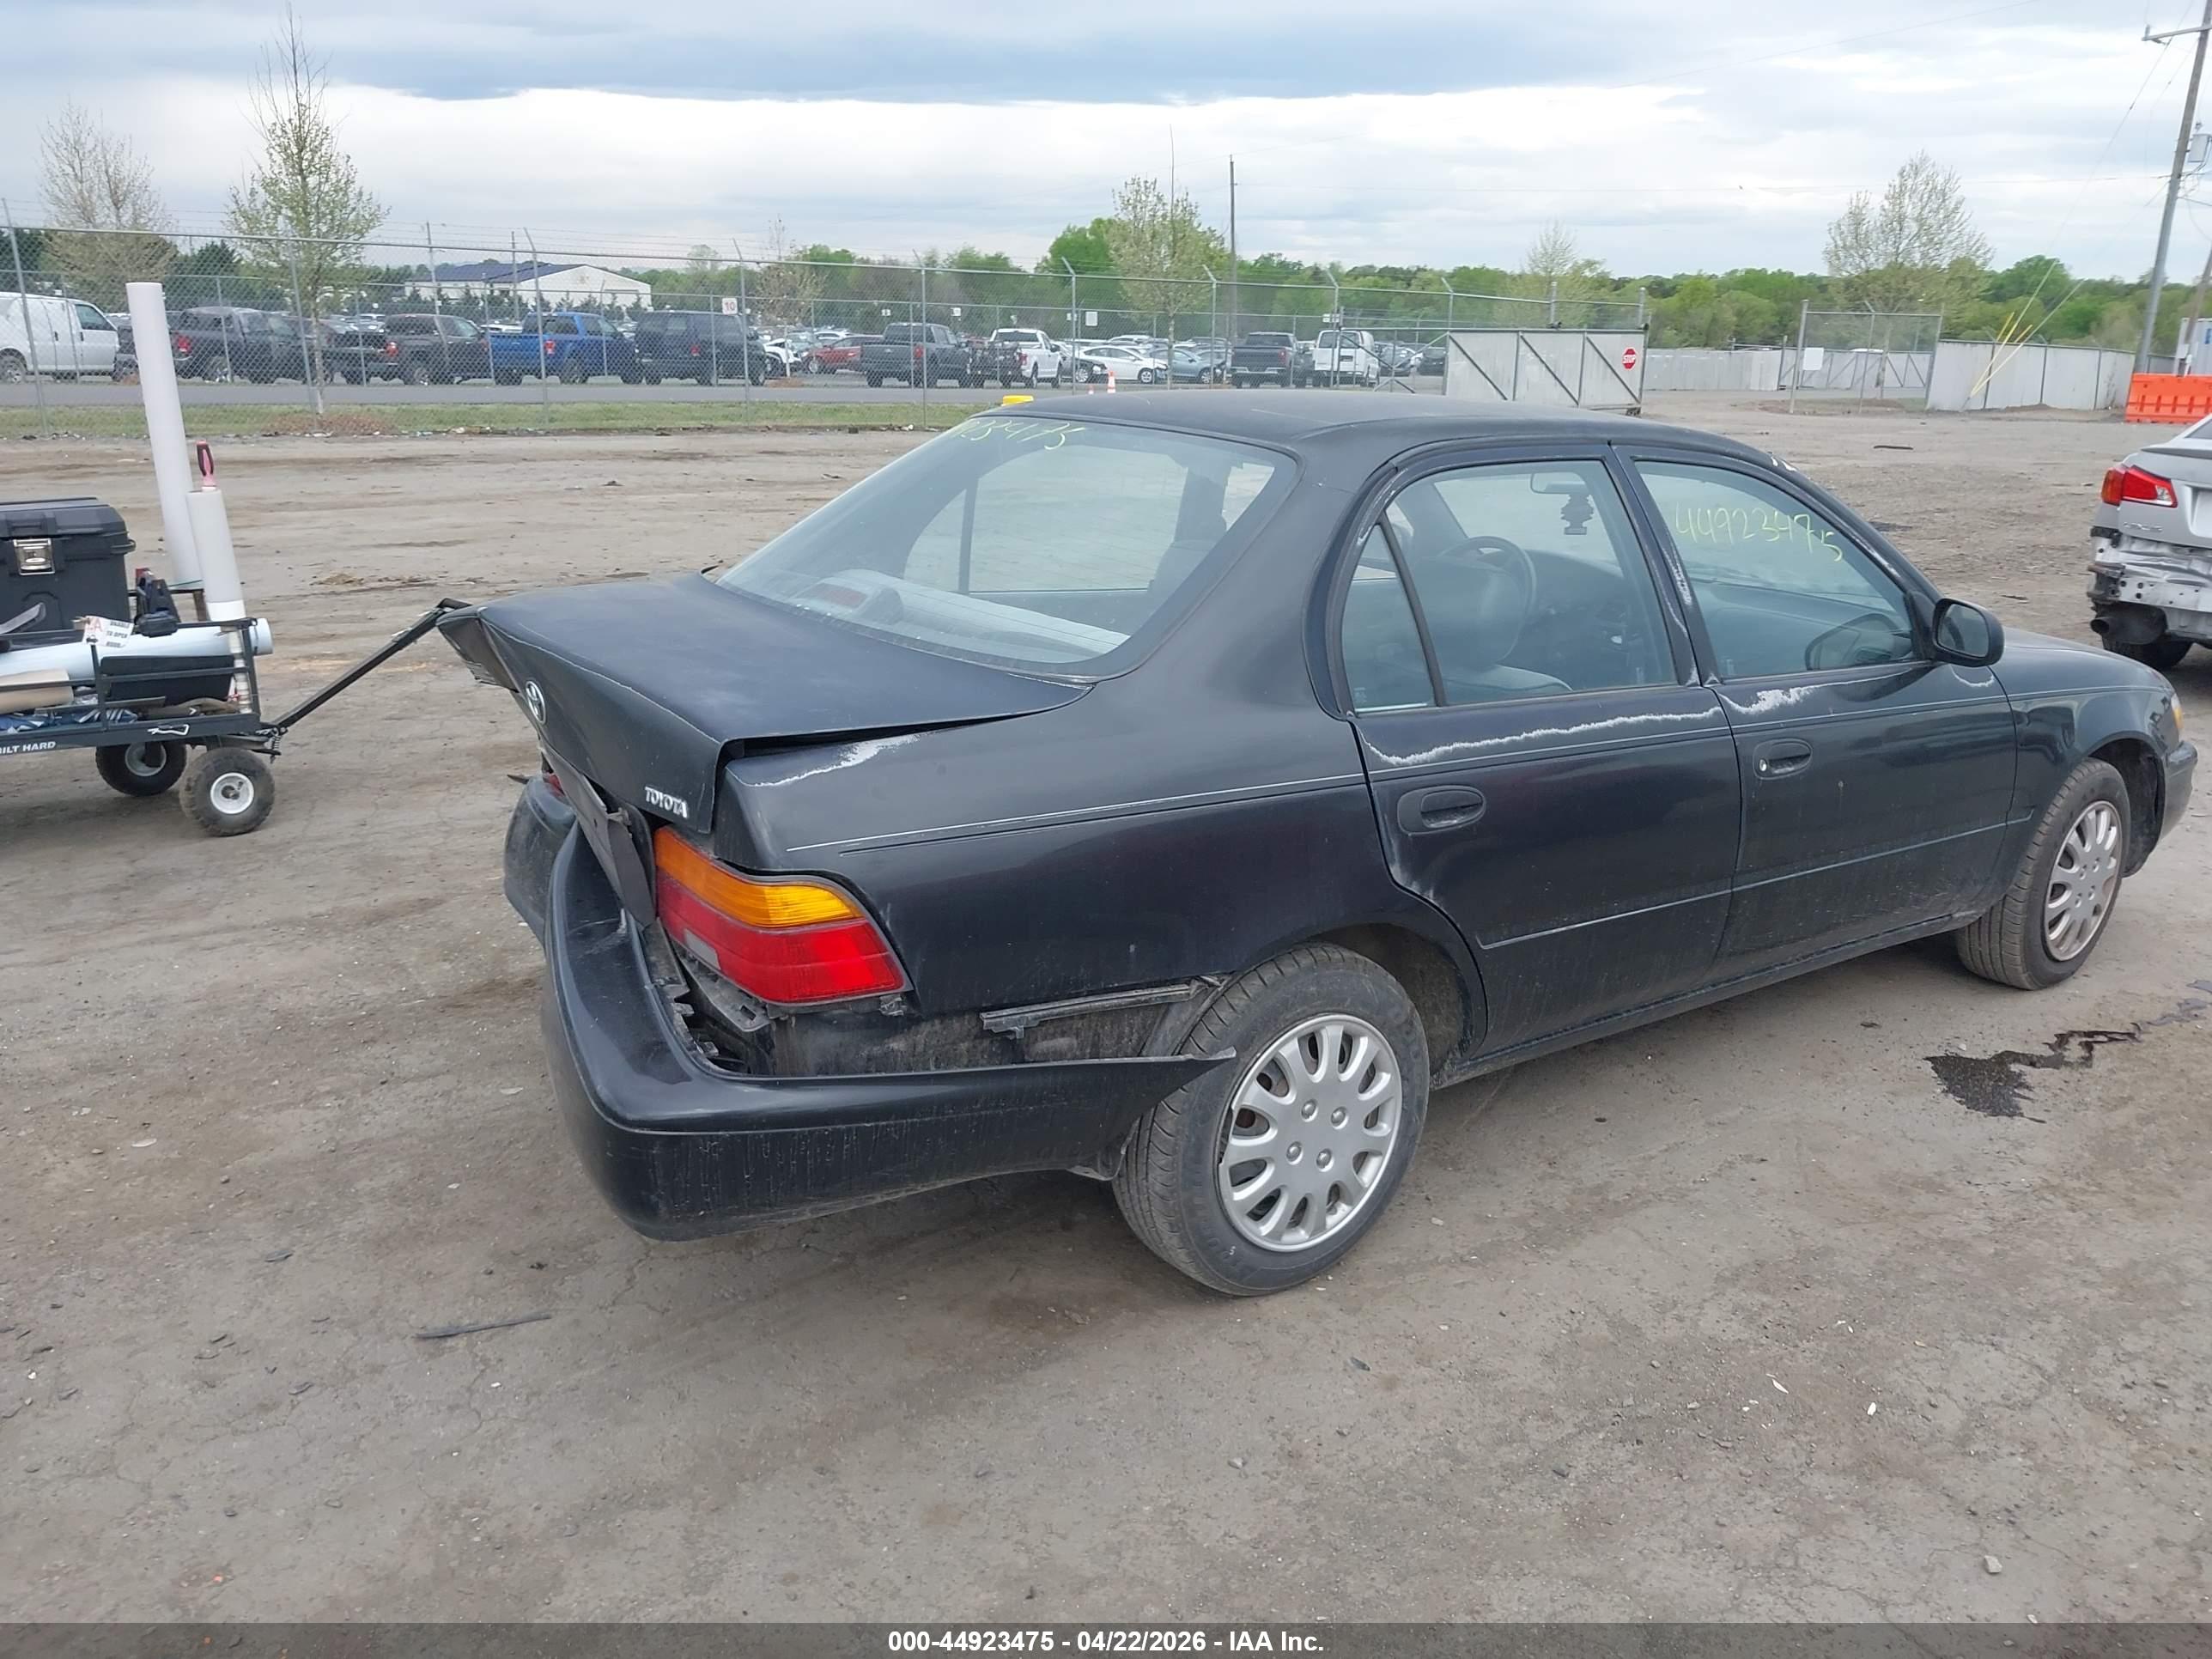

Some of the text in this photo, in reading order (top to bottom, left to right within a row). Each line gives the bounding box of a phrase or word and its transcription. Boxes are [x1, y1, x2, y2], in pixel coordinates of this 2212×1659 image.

[1623, 354, 1636, 364] STOP
[1675, 504, 1843, 562] 44923475
[22, 740, 57, 752] HARD
[645, 786, 688, 818] TOYOTA
